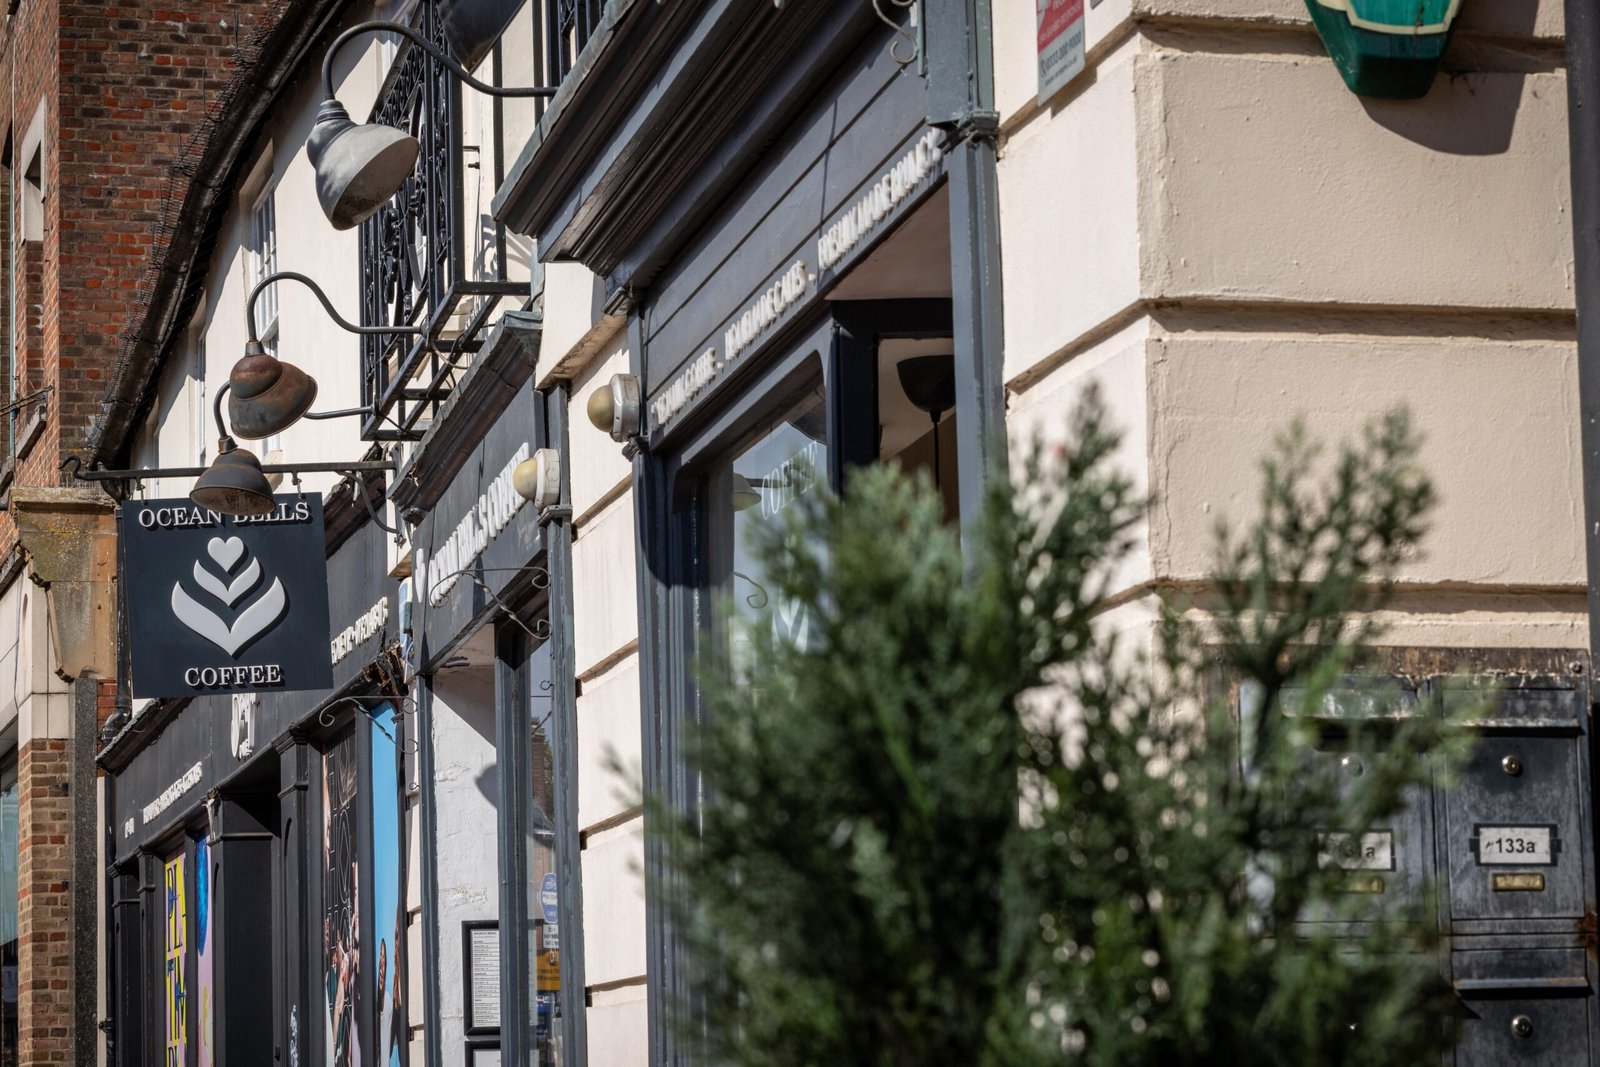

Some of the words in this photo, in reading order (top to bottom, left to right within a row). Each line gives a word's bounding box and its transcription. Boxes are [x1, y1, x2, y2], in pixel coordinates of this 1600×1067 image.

[138, 506, 222, 528] OCEAN
[184, 664, 281, 687] COFFEE
[1495, 838, 1536, 854] 133a
